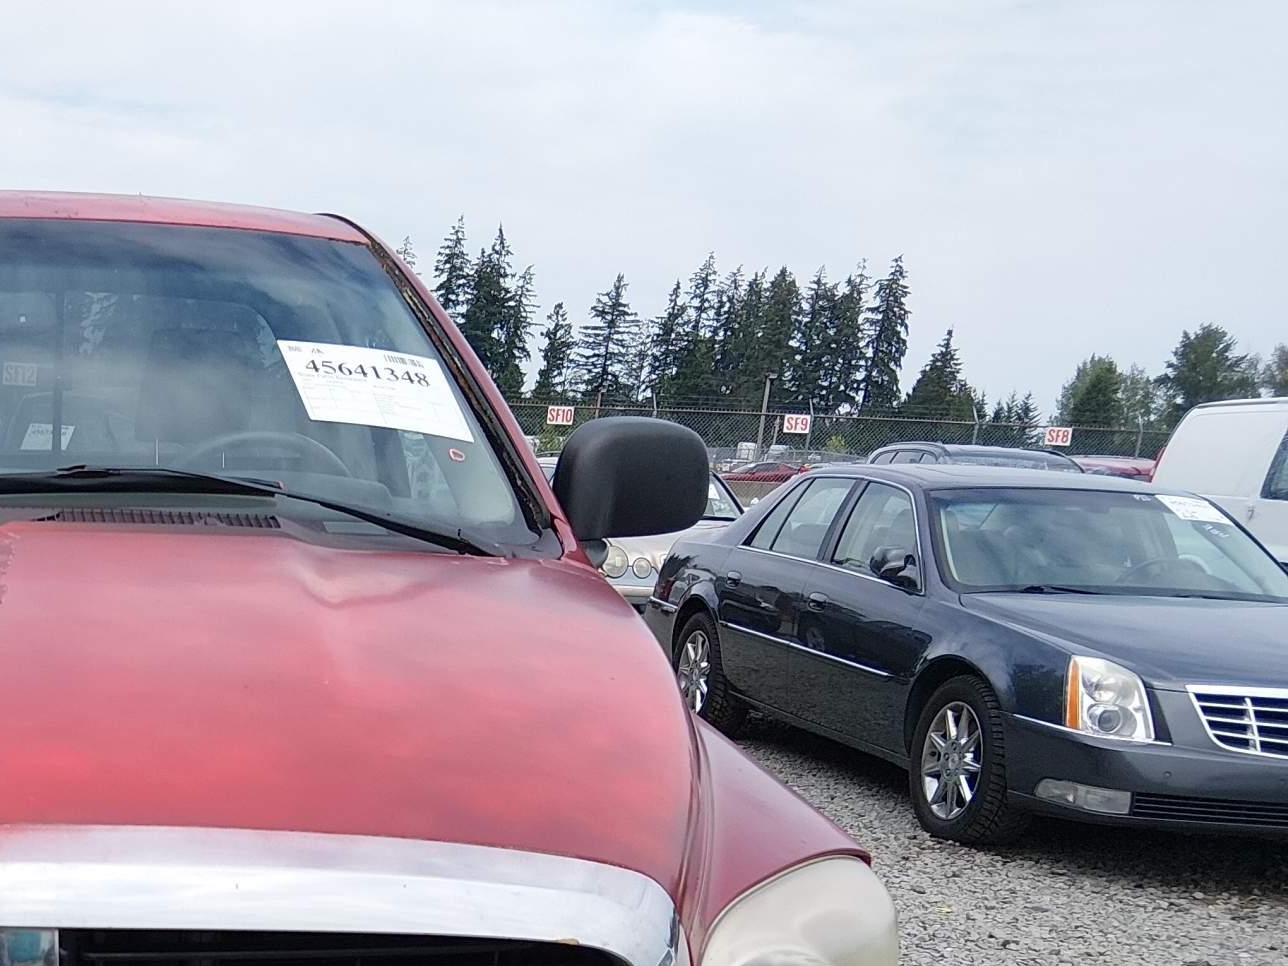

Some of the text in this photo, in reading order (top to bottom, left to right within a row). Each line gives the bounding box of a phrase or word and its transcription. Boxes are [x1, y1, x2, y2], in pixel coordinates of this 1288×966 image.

[305, 359, 431, 388] 45641348
[548, 408, 573, 423] SF10
[786, 416, 809, 431] SF9
[1047, 429, 1070, 443] SF8
